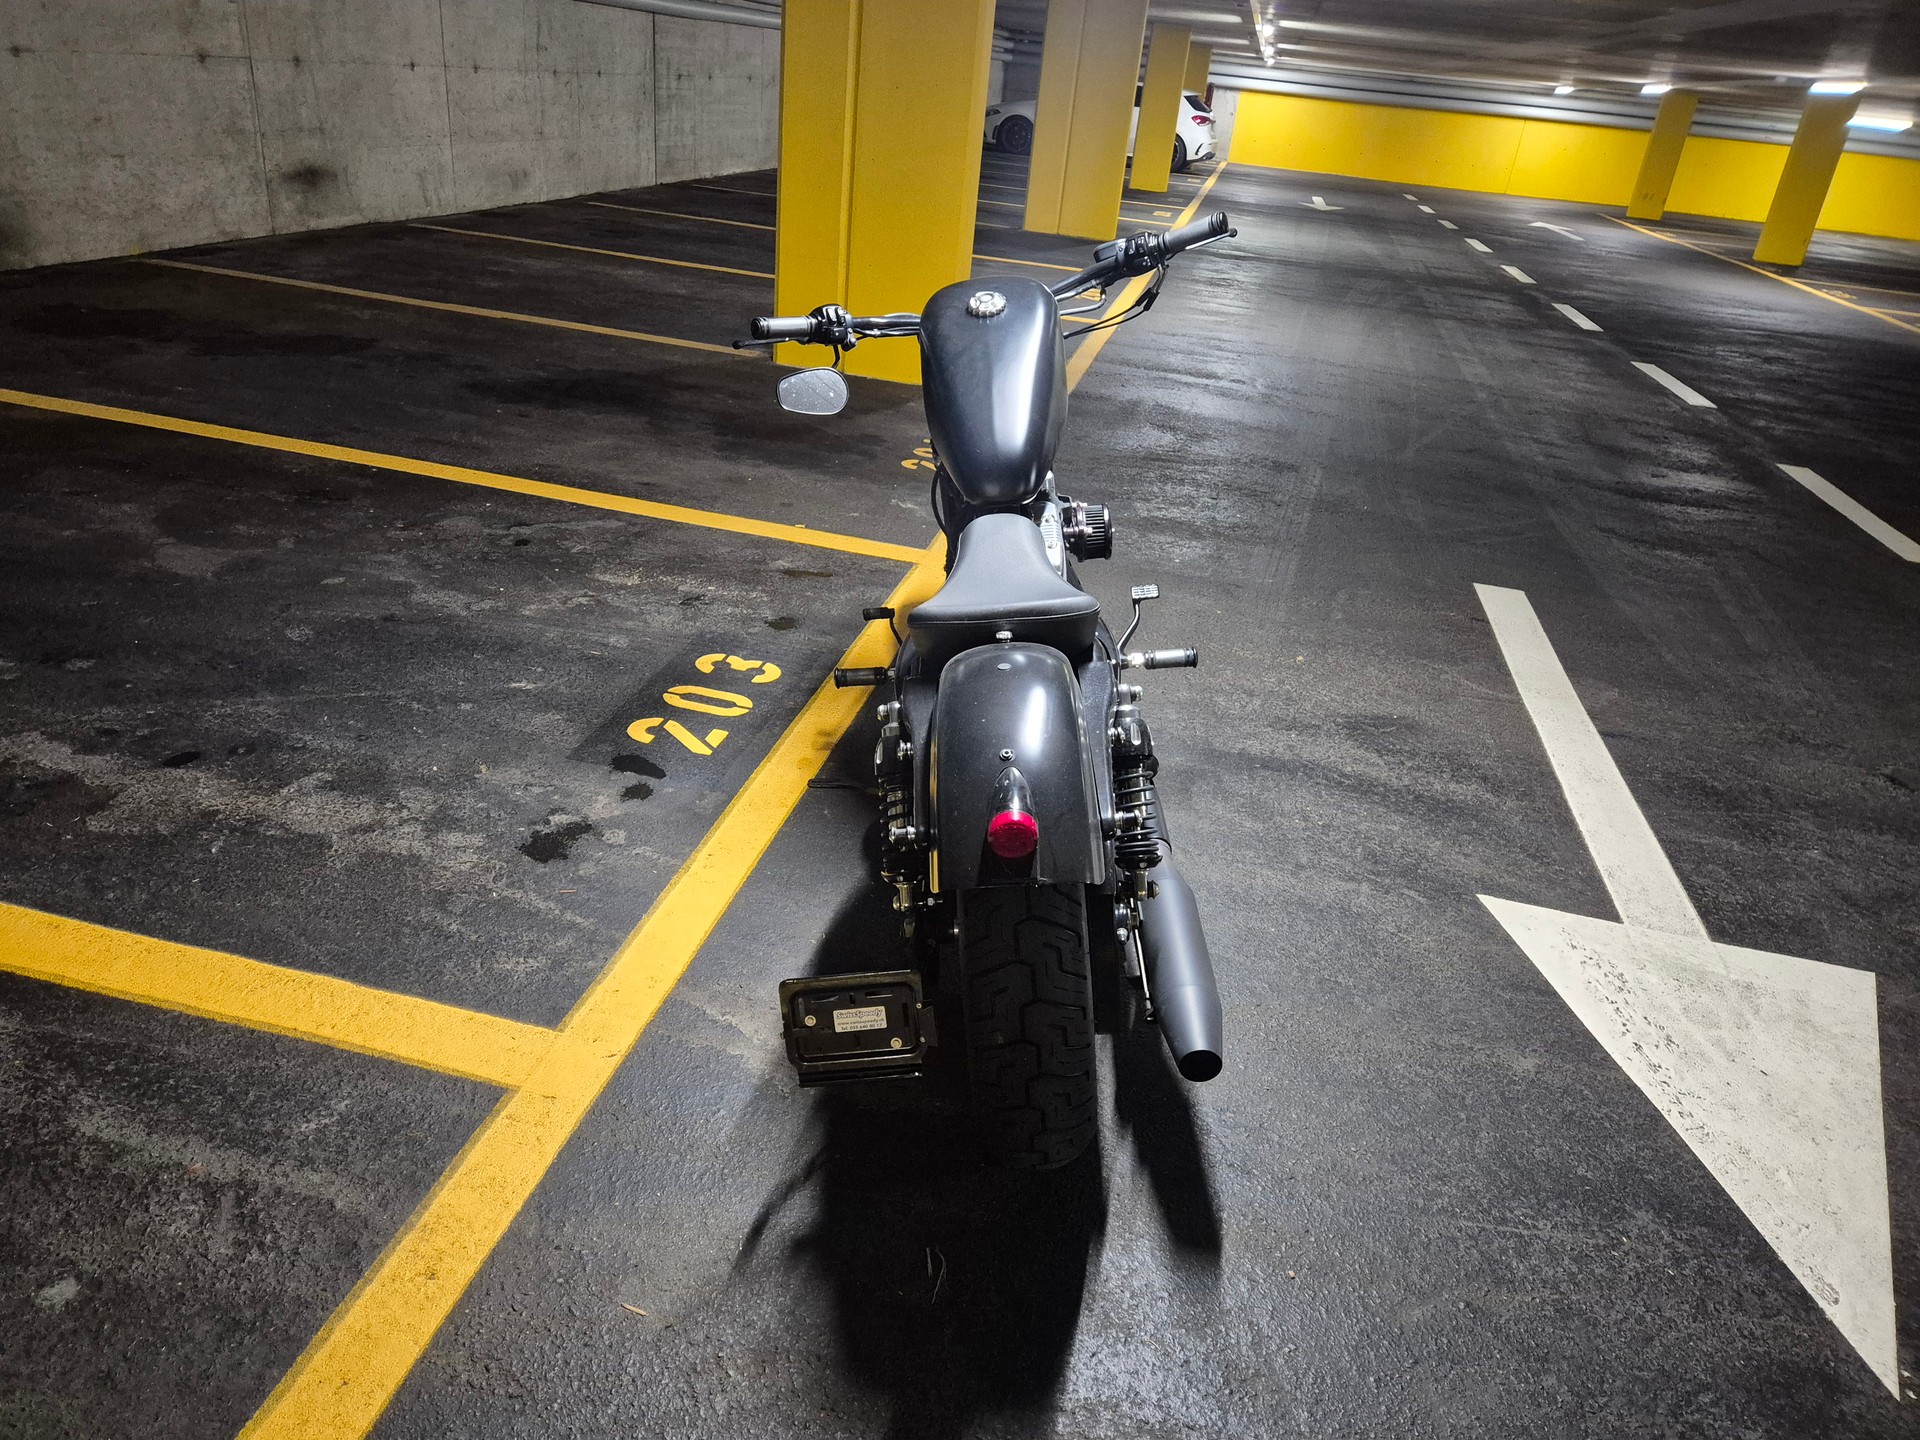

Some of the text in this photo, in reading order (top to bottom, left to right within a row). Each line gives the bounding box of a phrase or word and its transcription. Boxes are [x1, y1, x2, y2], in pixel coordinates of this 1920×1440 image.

[901, 439, 937, 471] 20
[627, 653, 782, 756] 203
[836, 1008, 883, 1019] SwissSpeedy
